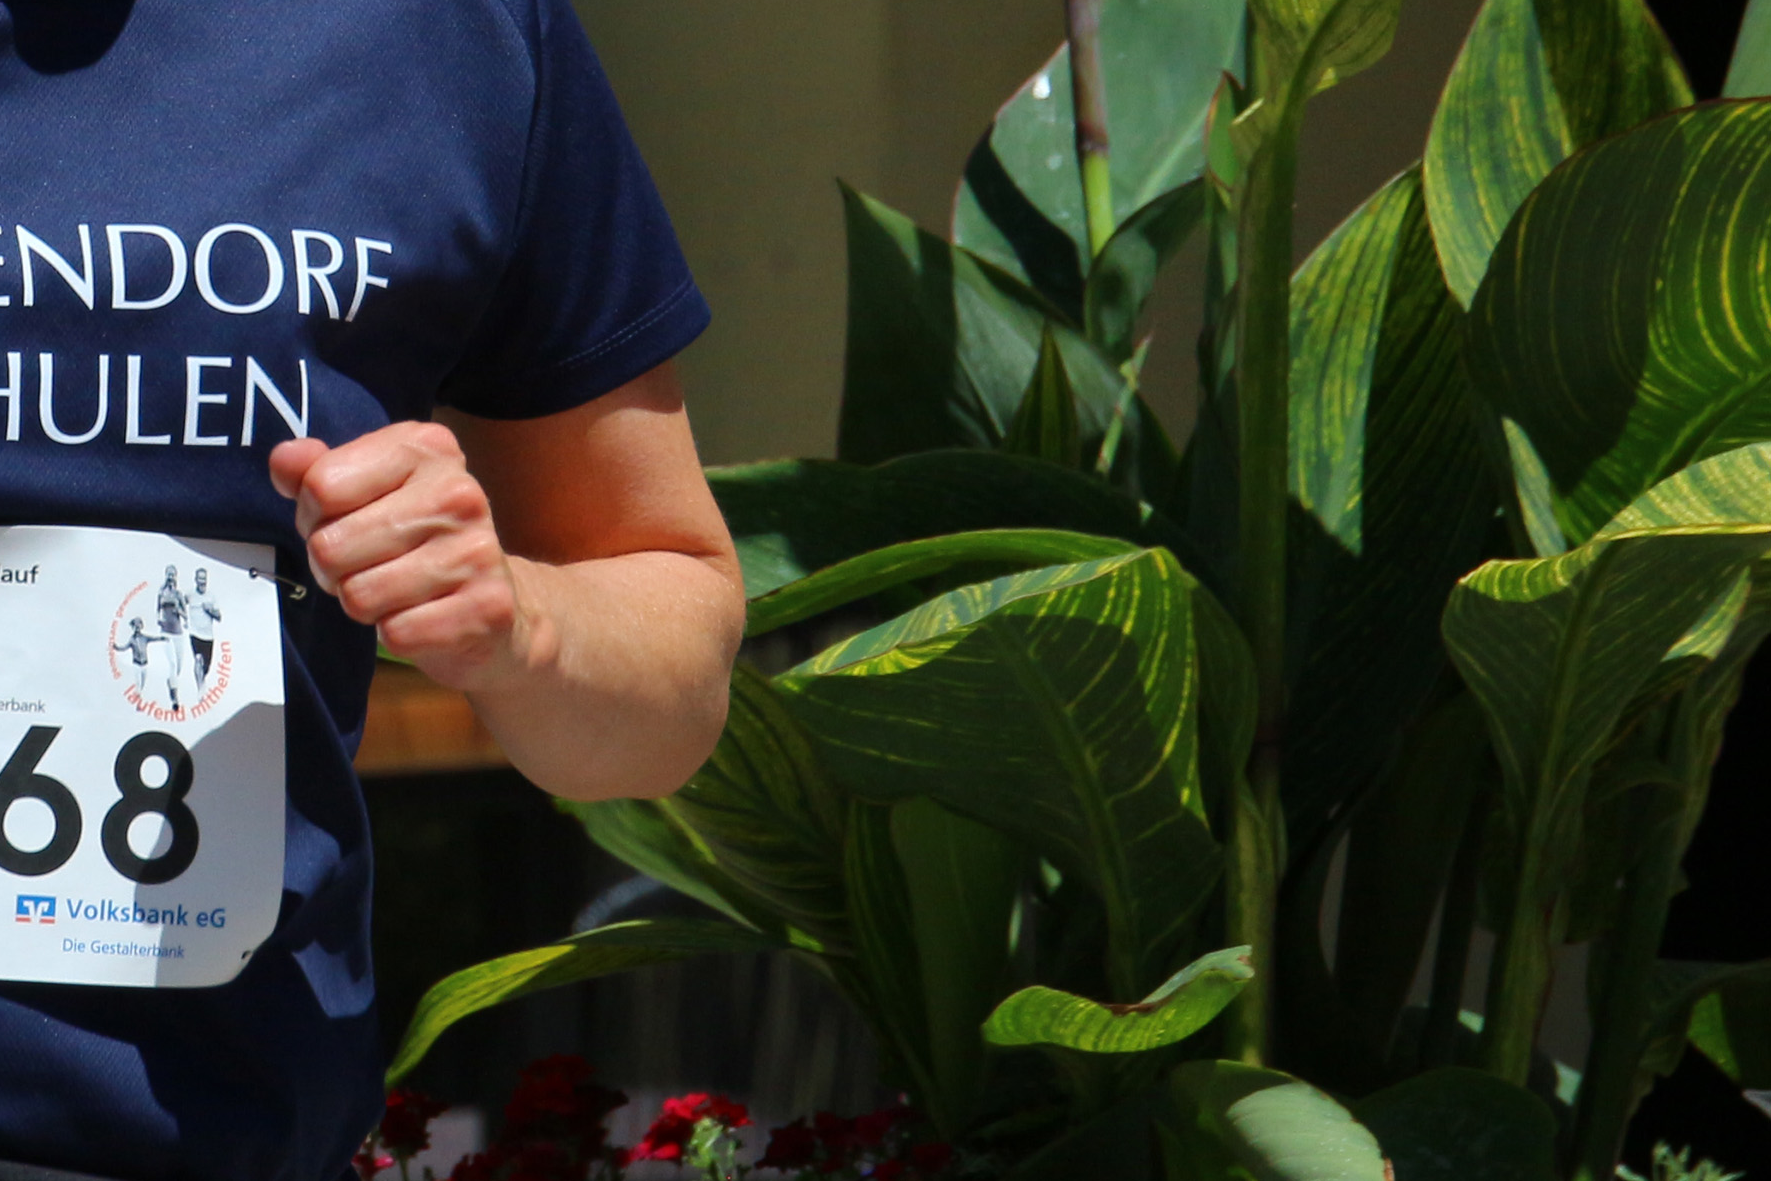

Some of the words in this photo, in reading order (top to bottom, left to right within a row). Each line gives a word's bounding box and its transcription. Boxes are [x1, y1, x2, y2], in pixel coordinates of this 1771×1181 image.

[123, 684, 186, 722] laufend
[190, 641, 232, 719] mithelfen
[66, 898, 188, 926] Volksbank
[196, 907, 226, 928] eG
[62, 938, 86, 953] Die
[90, 940, 185, 959] Gestalterbank
